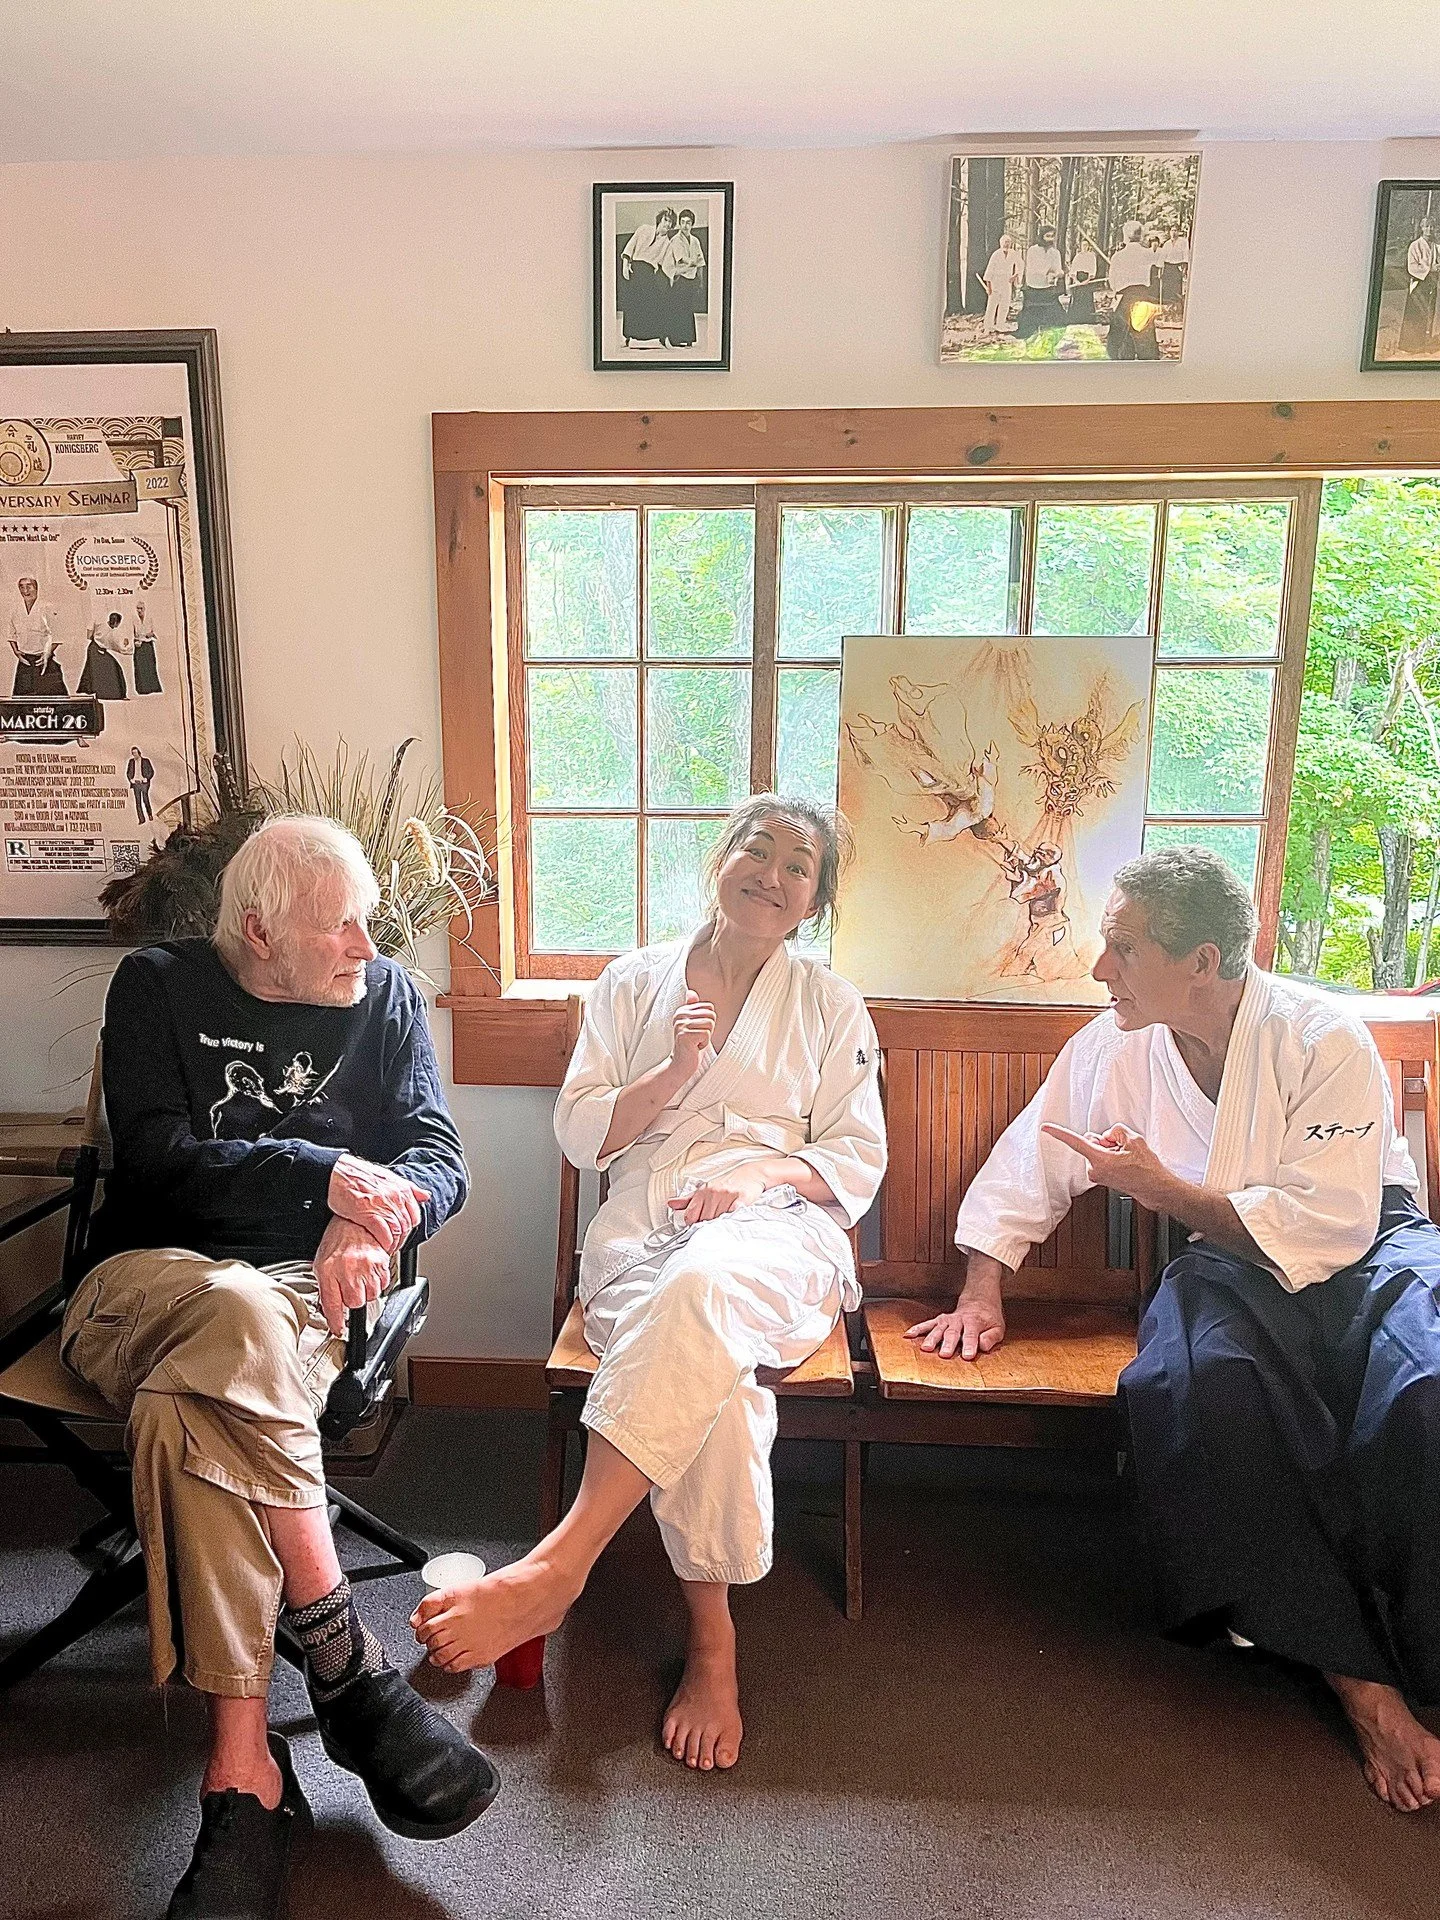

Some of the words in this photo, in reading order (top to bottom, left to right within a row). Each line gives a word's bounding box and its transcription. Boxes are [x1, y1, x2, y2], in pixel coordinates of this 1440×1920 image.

[54, 443, 99, 453] KONIGSBERG
[145, 477, 169, 489] 2022
[67, 490, 131, 507] SEMINAR
[77, 555, 146, 565] KONIGSBERG
[1, 715, 58, 729] MARCH
[62, 715, 88, 729] 26
[7, 841, 28, 856] R
[198, 1033, 220, 1047] True
[221, 1037, 254, 1052] Victory
